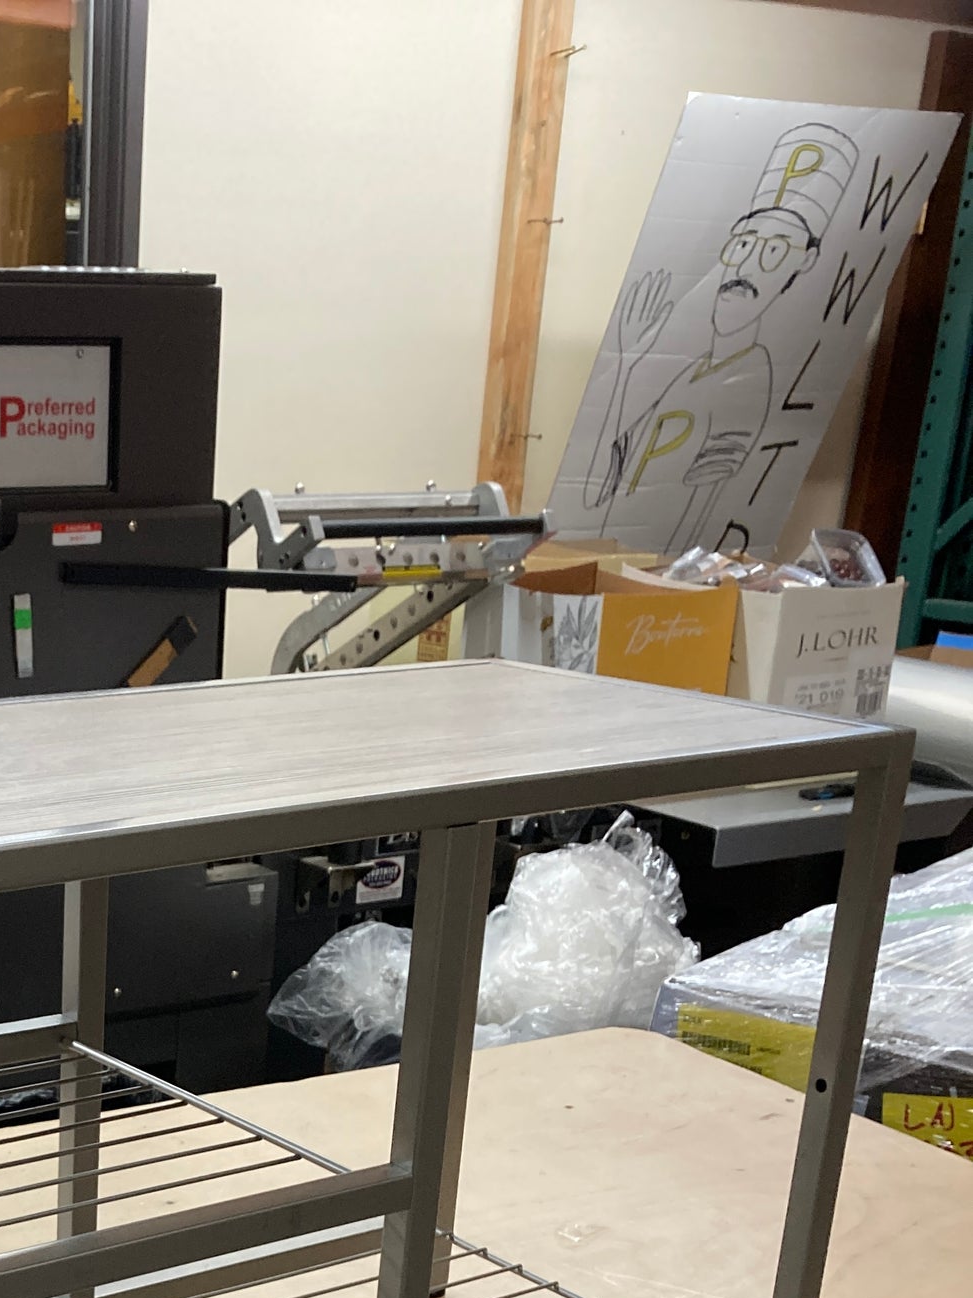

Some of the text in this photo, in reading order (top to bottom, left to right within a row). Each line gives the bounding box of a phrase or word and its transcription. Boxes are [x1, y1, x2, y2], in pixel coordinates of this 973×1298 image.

[774, 143, 824, 208] P
[0, 396, 95, 438] Preferred
[626, 409, 694, 494] P
